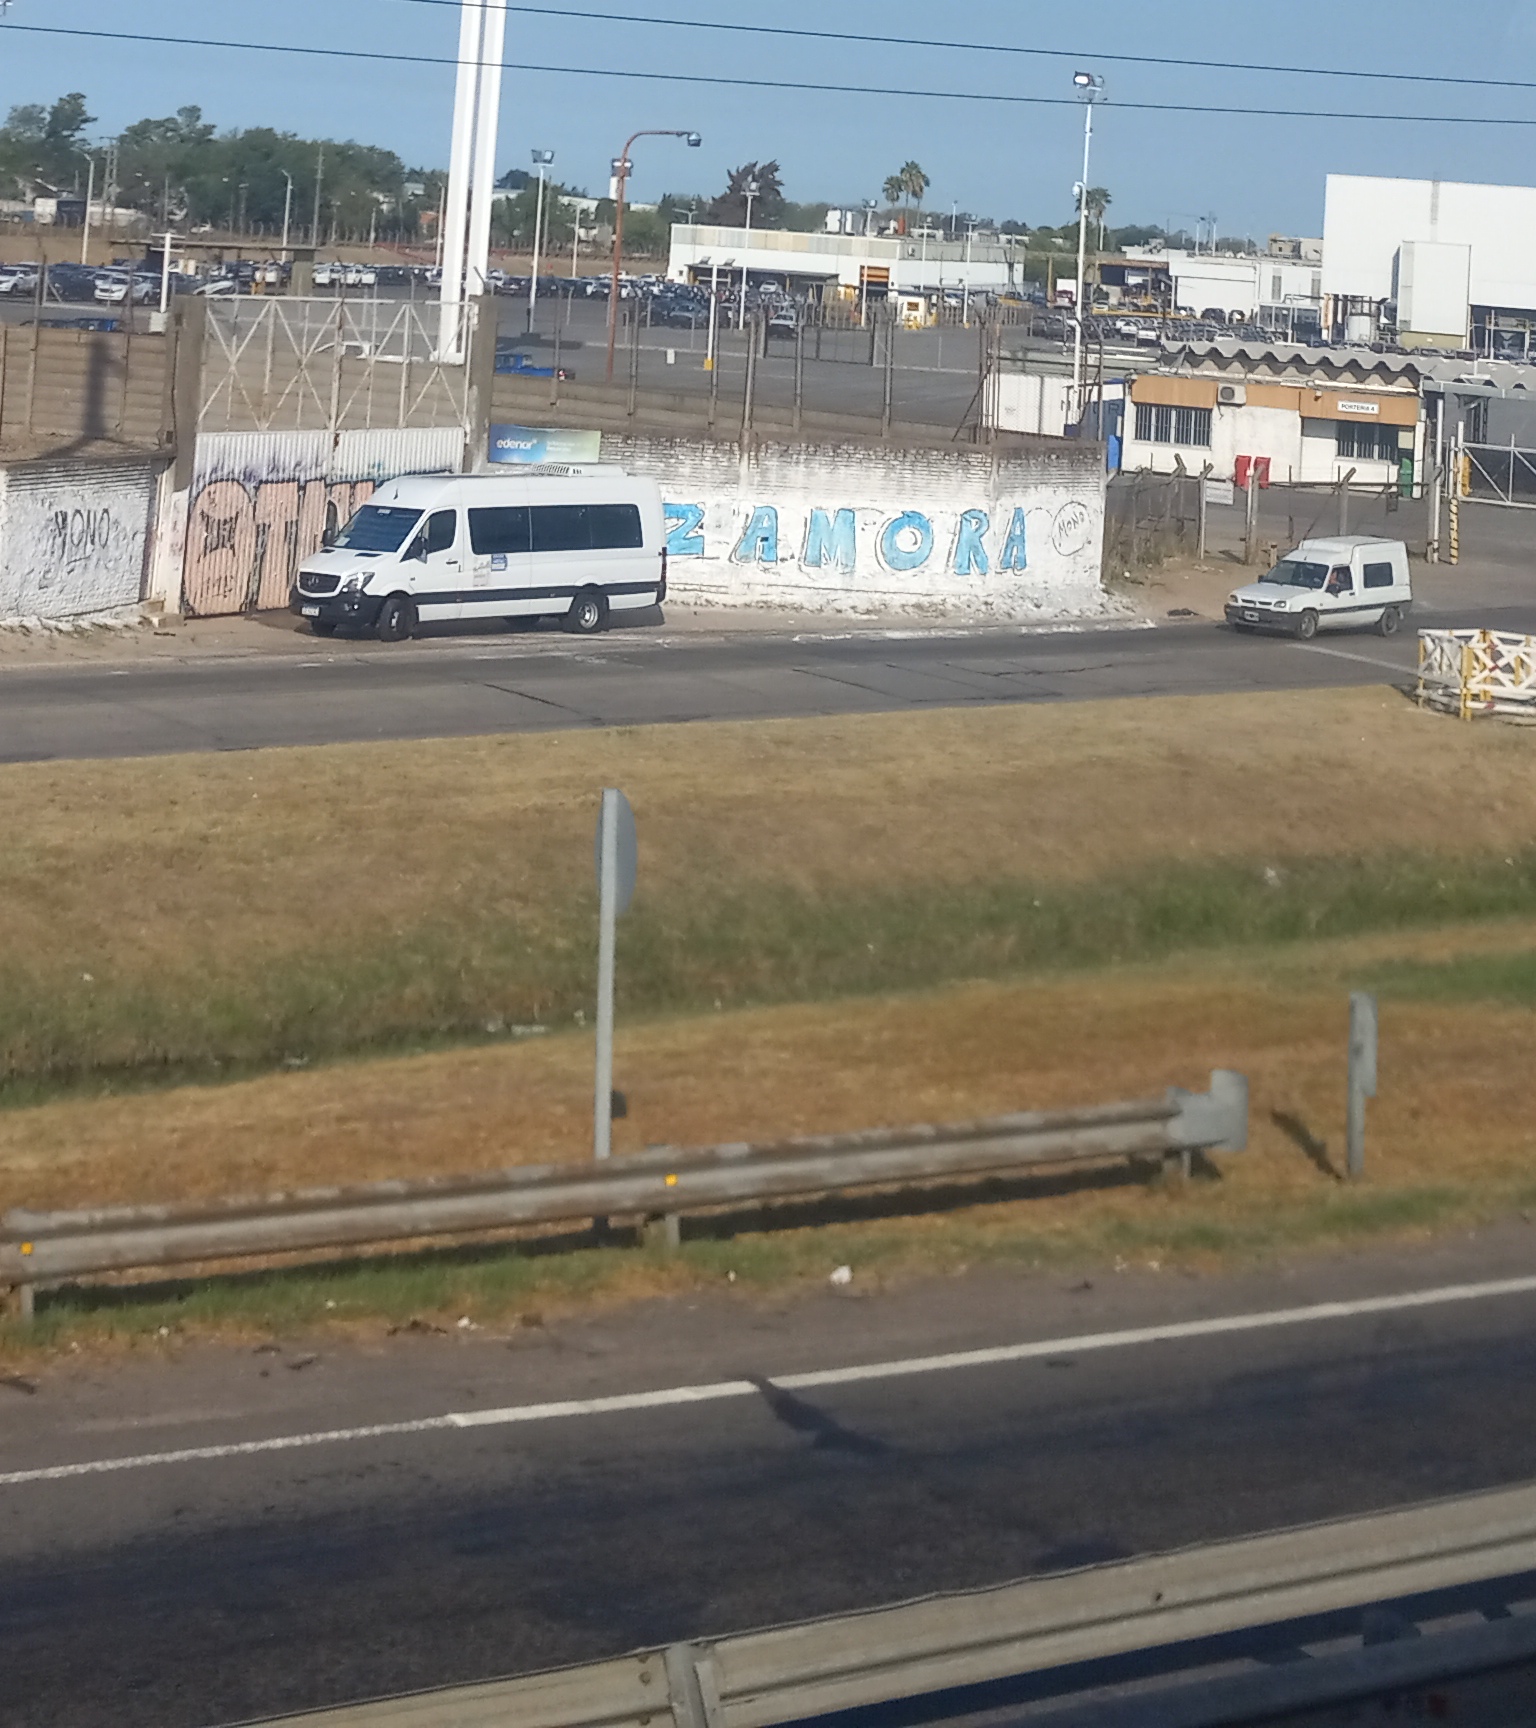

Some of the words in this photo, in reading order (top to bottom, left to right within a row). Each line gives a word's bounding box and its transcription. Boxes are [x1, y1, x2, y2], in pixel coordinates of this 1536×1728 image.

[496, 437, 535, 450] edenor
[1058, 509, 1085, 538] MONO
[661, 502, 1028, 576] ZAMORA
